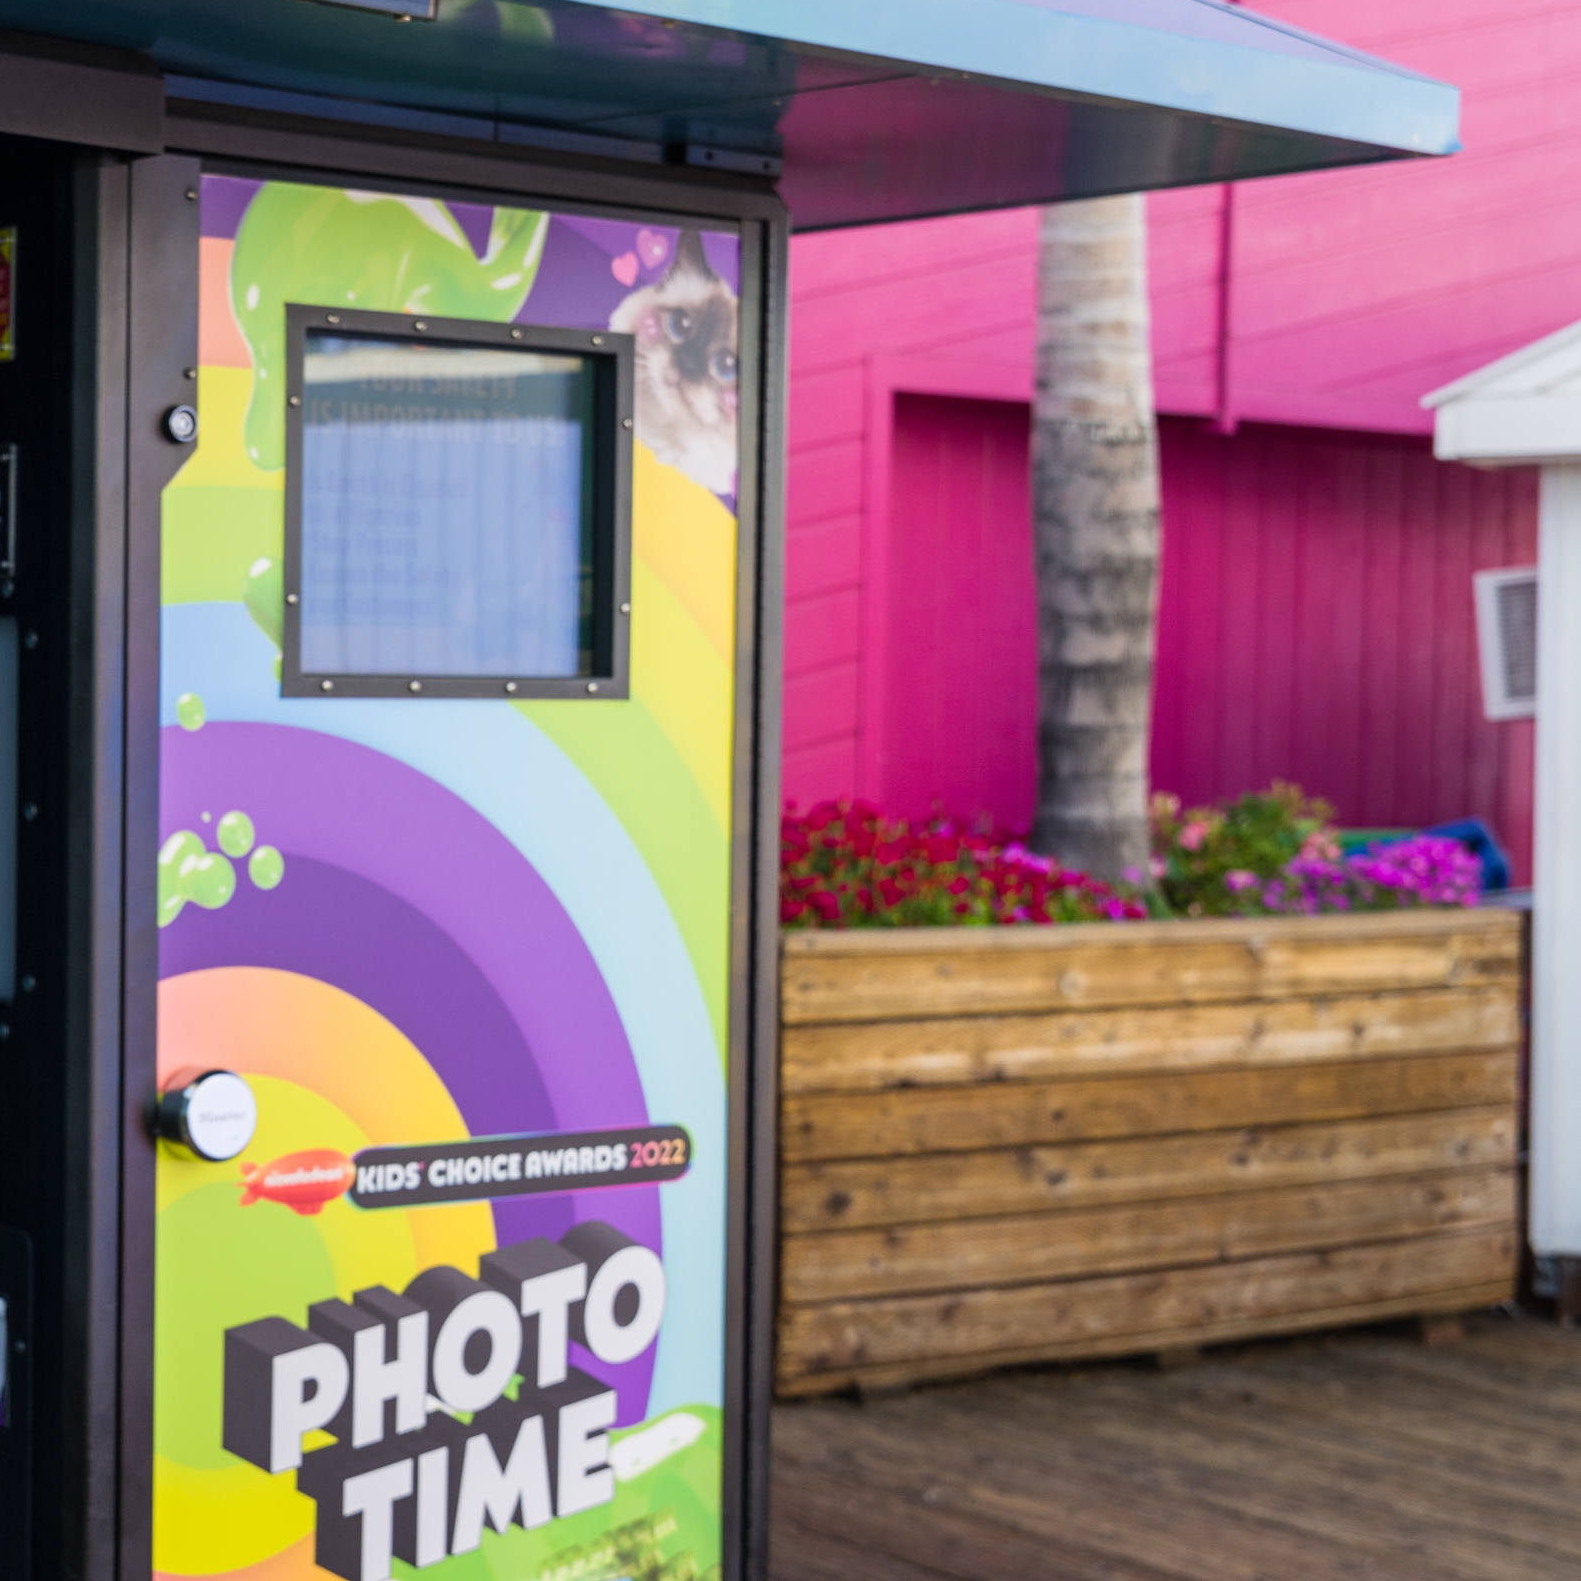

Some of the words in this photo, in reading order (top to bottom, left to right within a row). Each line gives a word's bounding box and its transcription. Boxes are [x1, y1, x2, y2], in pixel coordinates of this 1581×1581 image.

[356, 1161, 425, 1195] KIDS'
[427, 1152, 522, 1188] CHOICE
[525, 1142, 628, 1180] AWARDS
[630, 1137, 686, 1169] 2022
[268, 1242, 668, 1476] PHOTO
